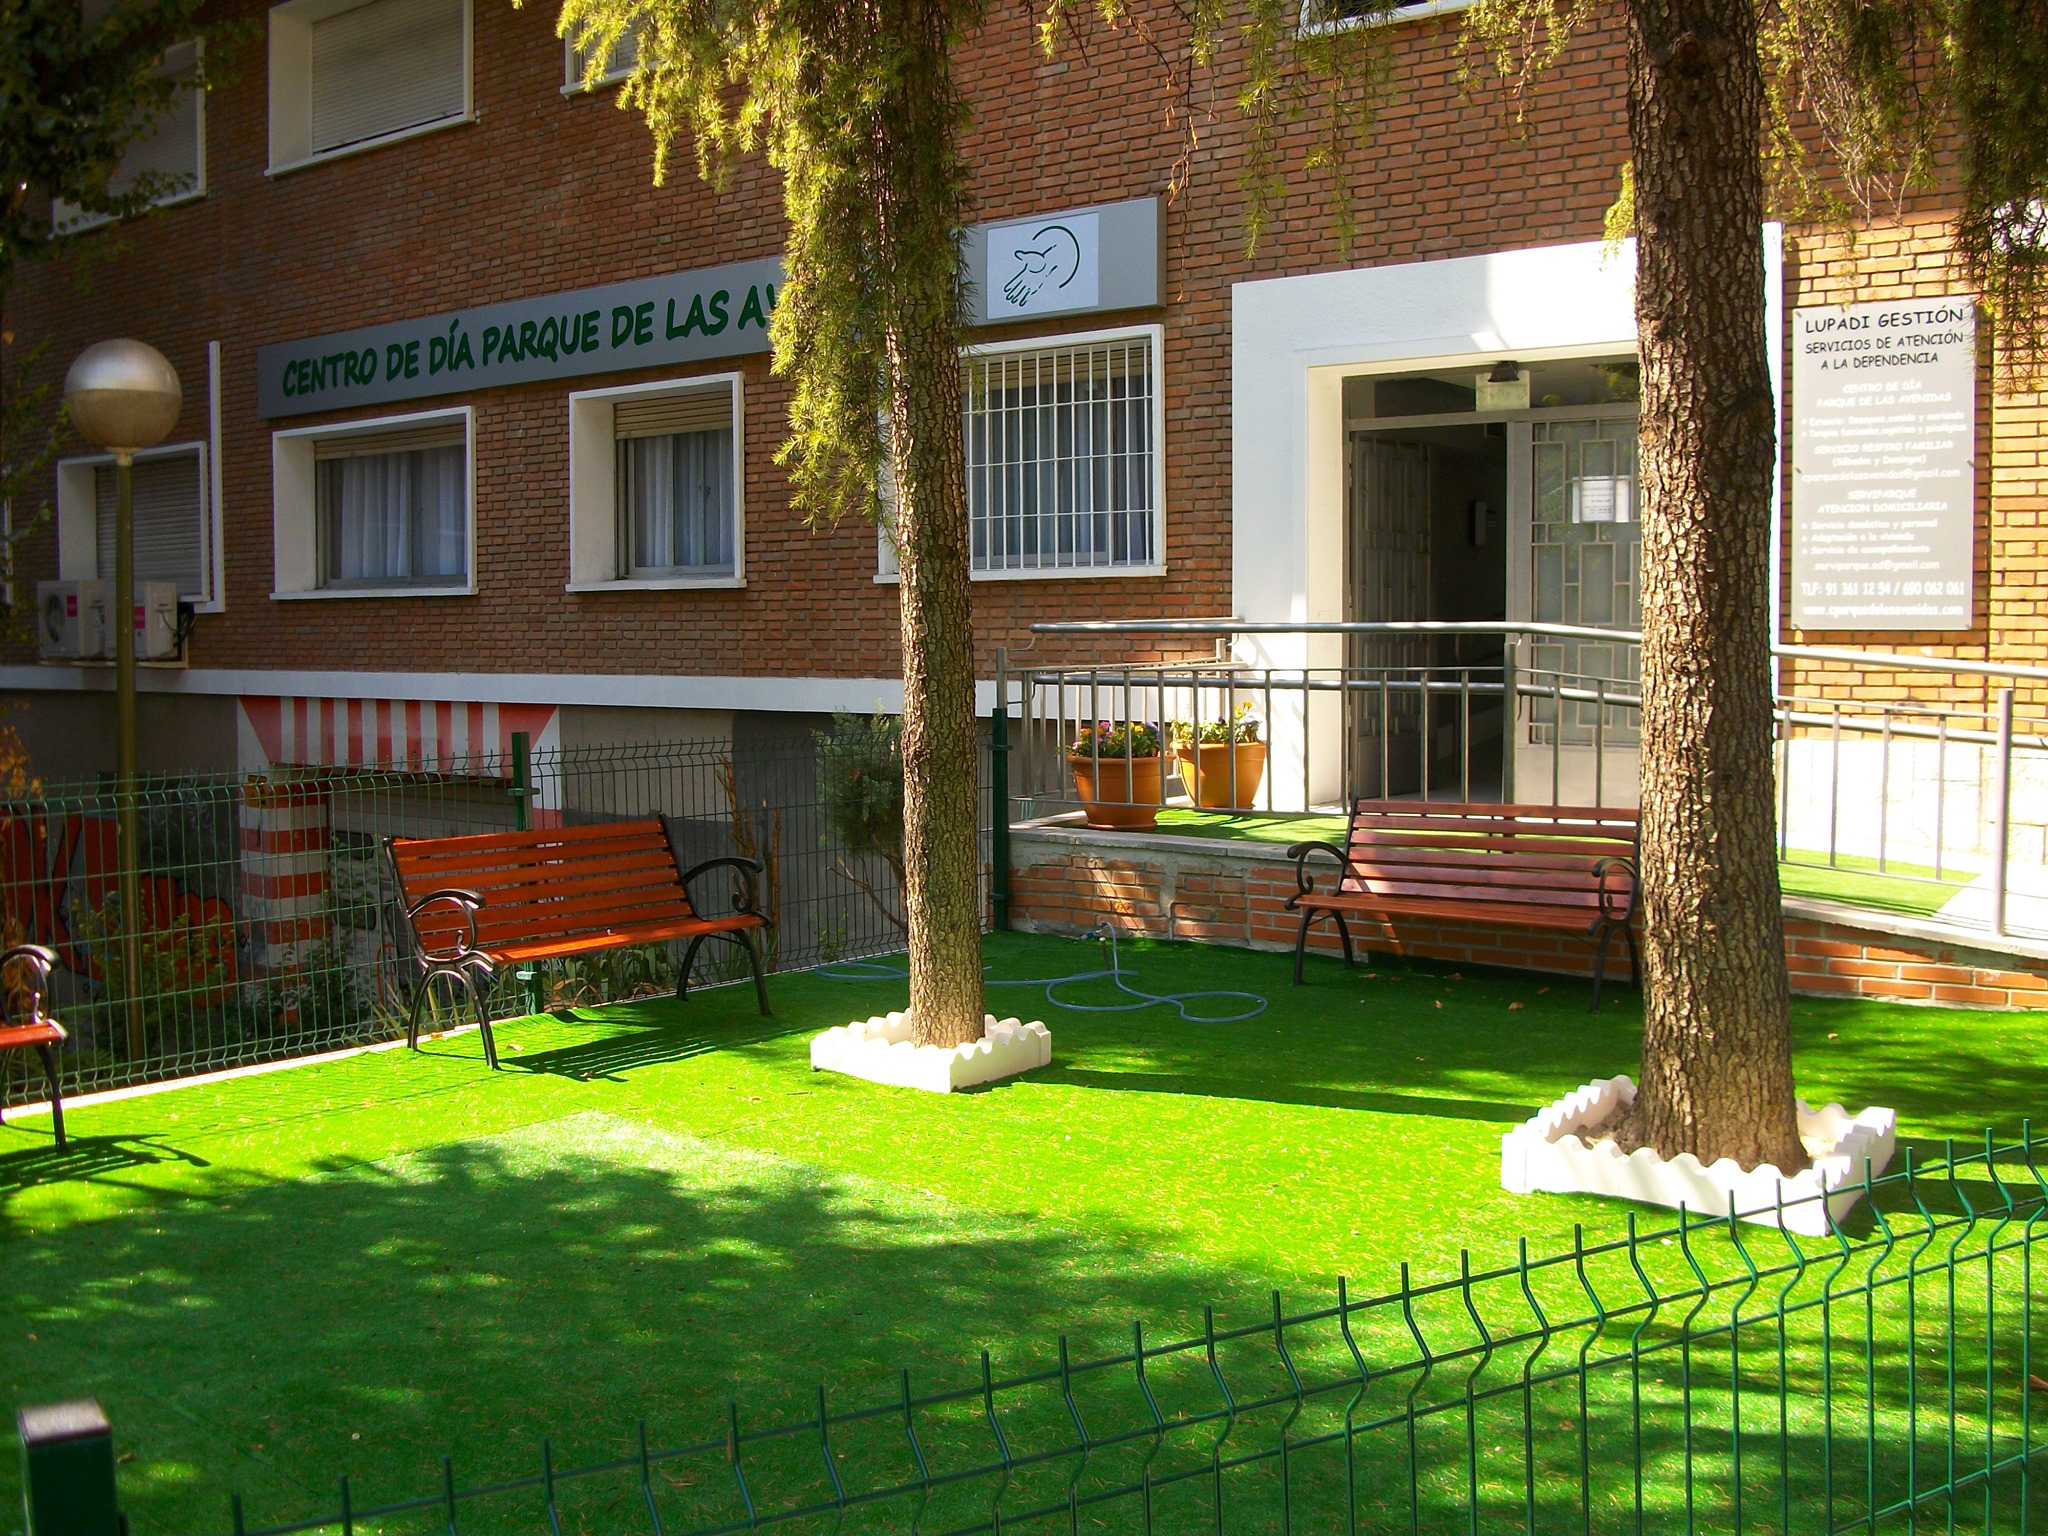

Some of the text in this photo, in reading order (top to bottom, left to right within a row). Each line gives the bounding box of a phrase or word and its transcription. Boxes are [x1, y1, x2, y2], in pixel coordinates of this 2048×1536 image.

[1805, 305, 1963, 333] LUPADI GESTIÓN
[283, 347, 378, 398] CENTRO
[386, 340, 421, 380] DE
[429, 318, 474, 376] DÍA
[482, 309, 601, 365] PARQUE
[611, 301, 654, 350] DE
[665, 289, 729, 341] LAS
[1805, 329, 1963, 354] SERVICIOS DE ATENCIÓN
[1820, 352, 1939, 370] A LA DEPENDENCIA
[1842, 378, 1922, 394] CENTRO DE DÍA
[1816, 392, 1952, 408] PARQUE DE LAS AVENIDAS
[1814, 440, 1954, 454] SERVICIO RESPIRO FAMILIAR
[1874, 457, 1881, 466] y
[1847, 489, 1917, 500] SERVIPARQUE
[1873, 501, 1948, 513] DOMICILIARIA
[1811, 520, 1845, 530] Servicio
[1893, 521, 1899, 530] y
[1901, 518, 1938, 530] personal
[1868, 532, 1877, 541] la
[1810, 545, 1844, 555] Servicio
[1847, 545, 1858, 554] de
[1801, 582, 1822, 596] TLF:
[1825, 582, 1837, 596] 91
[1841, 582, 1858, 596] 361
[1863, 582, 1875, 595] 12
[1924, 581, 1943, 595] 062
[1947, 581, 1965, 595] 061
